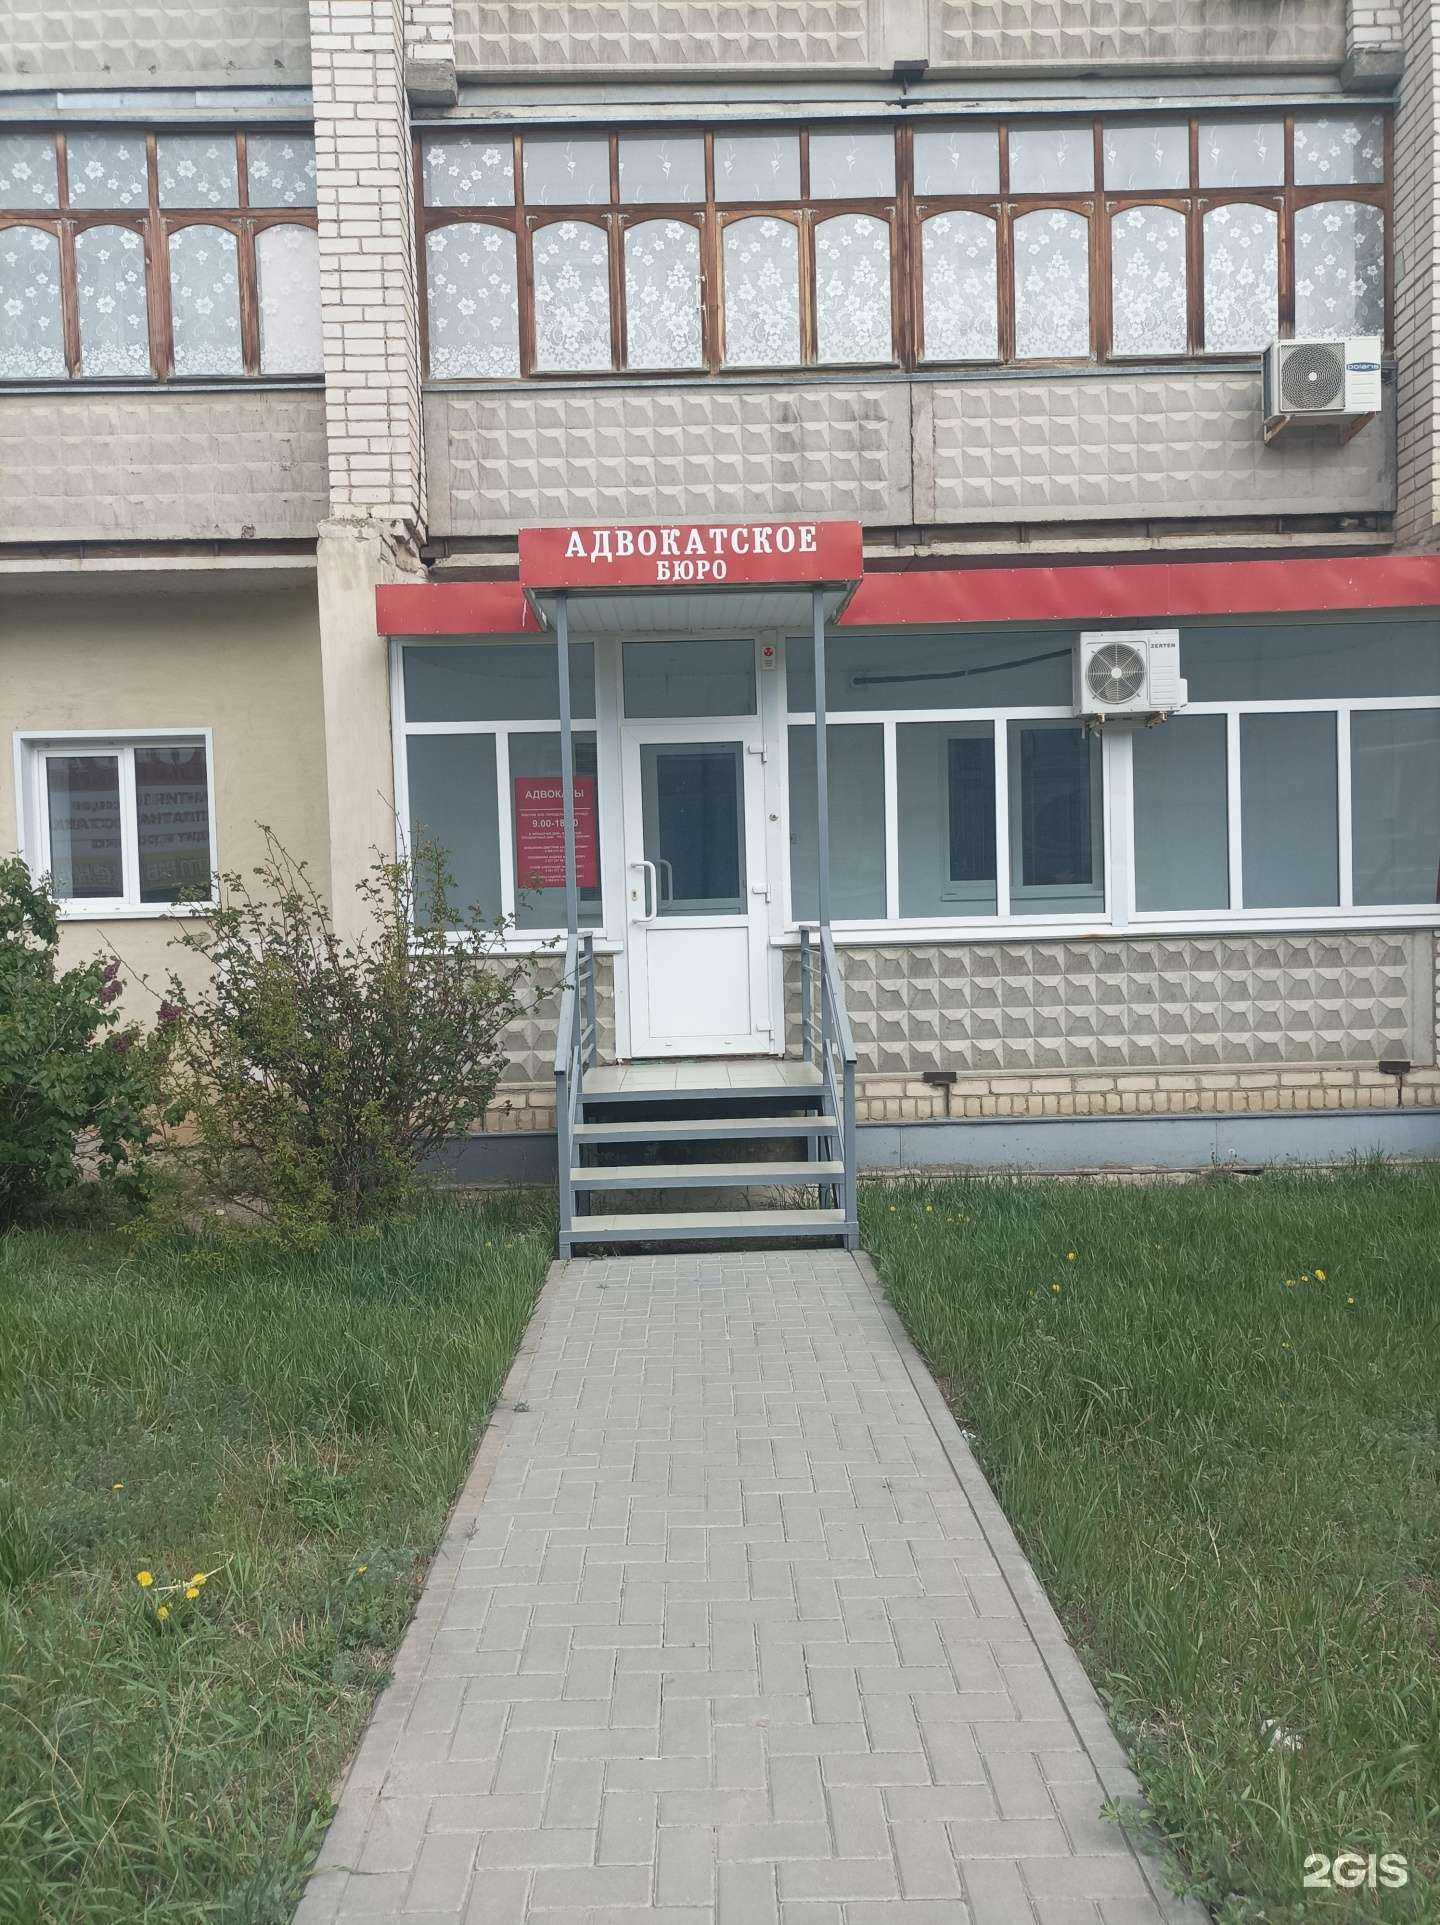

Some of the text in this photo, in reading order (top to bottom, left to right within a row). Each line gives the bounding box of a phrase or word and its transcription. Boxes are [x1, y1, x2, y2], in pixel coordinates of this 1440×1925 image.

[564, 526, 817, 563] АДВОКАТСКОЕ
[656, 559, 728, 581] БЮРО
[525, 789, 584, 800] АДВОКЫ
